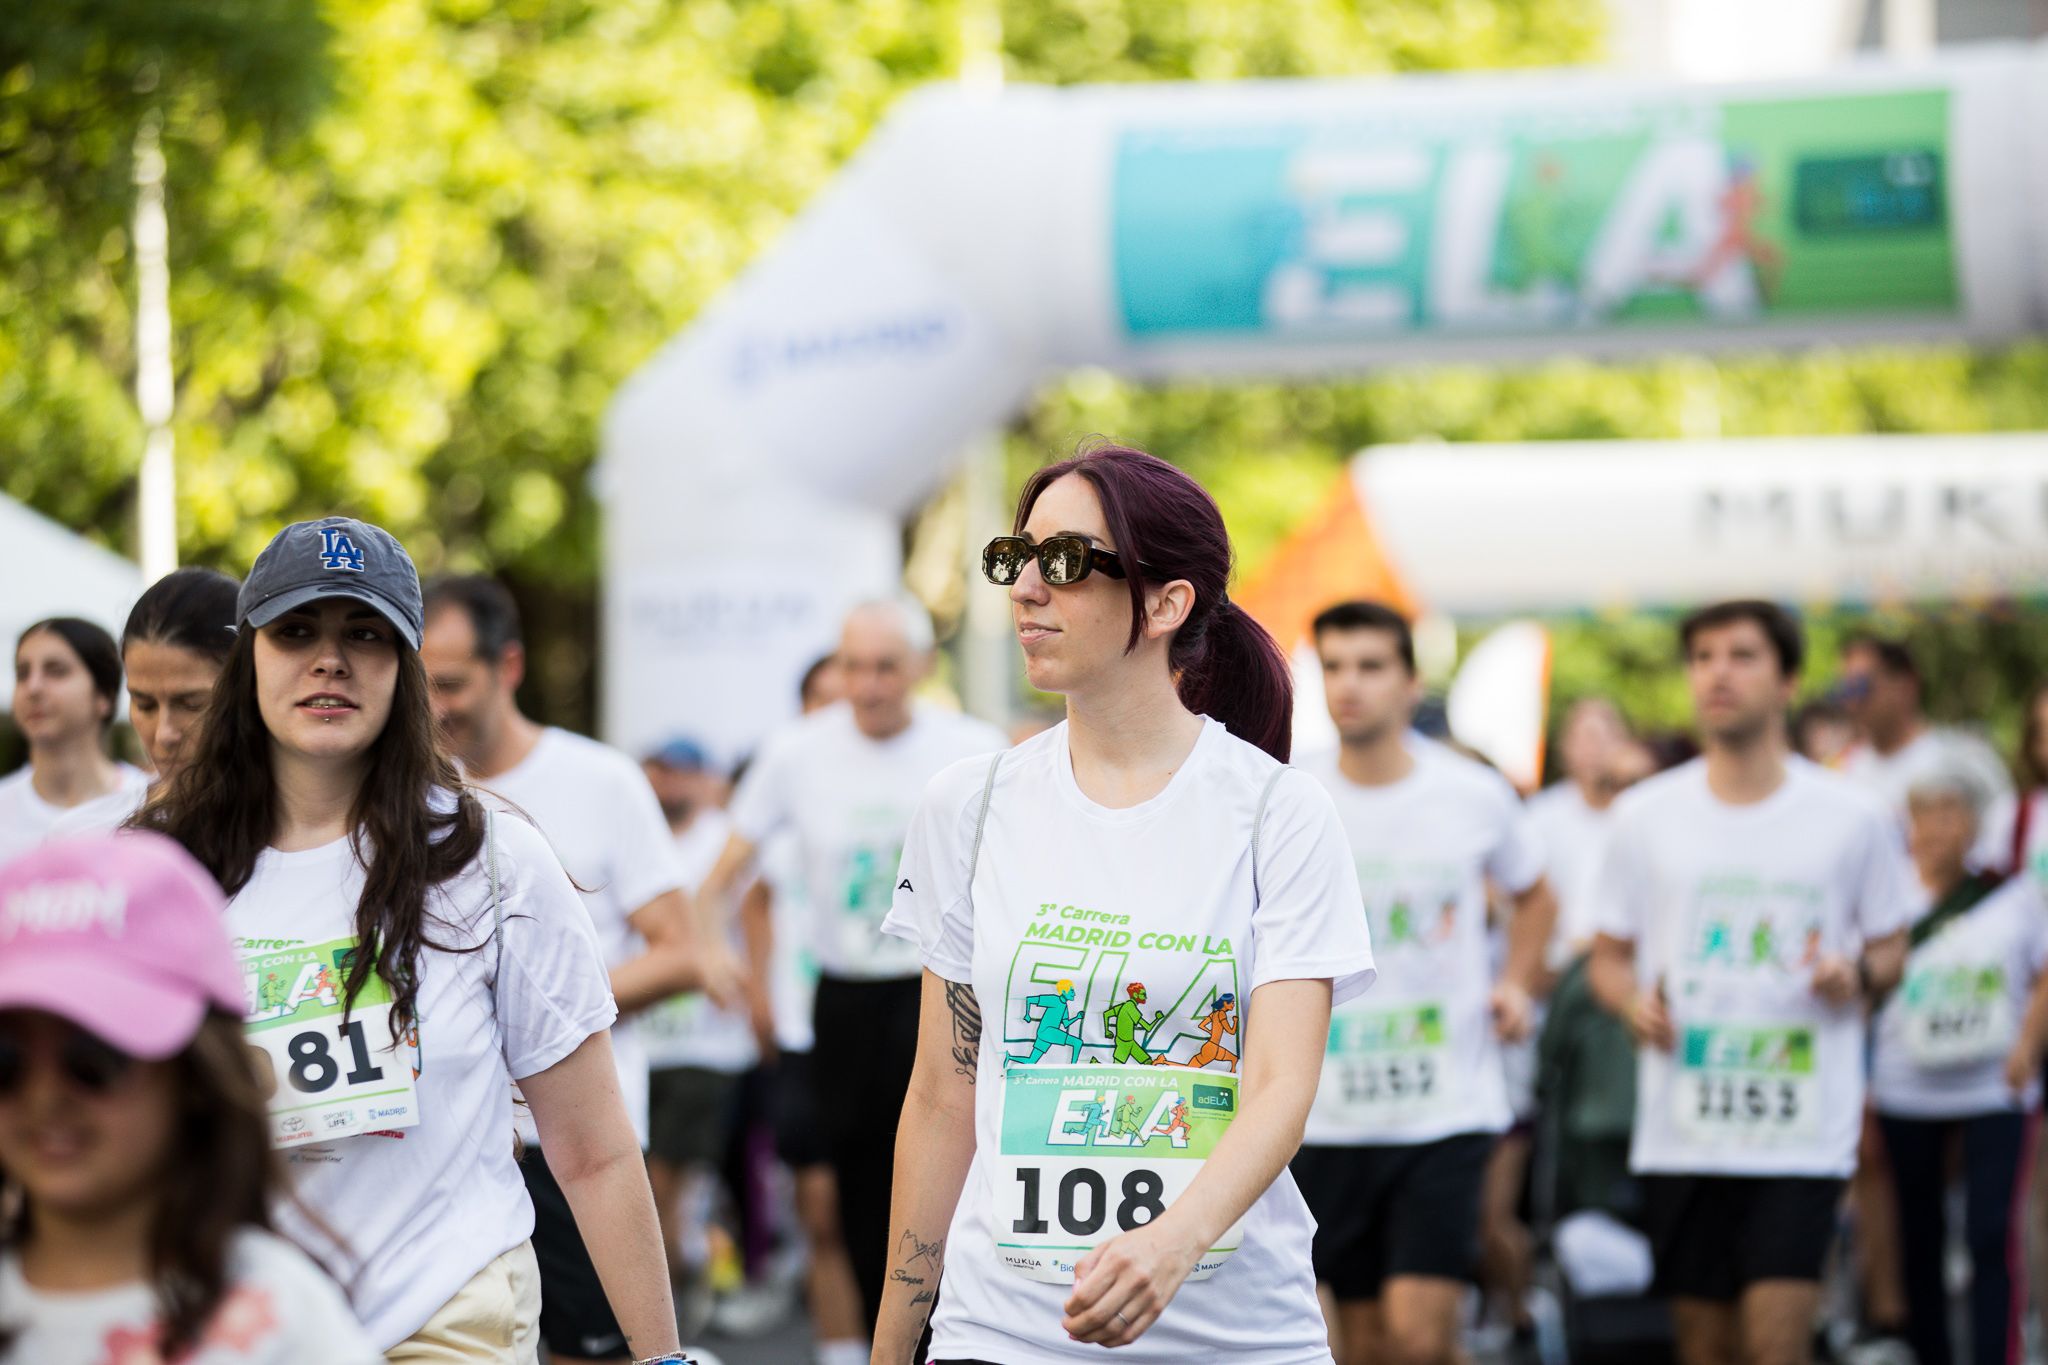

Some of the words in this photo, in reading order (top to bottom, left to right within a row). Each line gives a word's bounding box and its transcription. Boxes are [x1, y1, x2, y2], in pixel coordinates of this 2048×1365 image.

[1262, 136, 1764, 325] ELA
[1694, 482, 2048, 546] MUK
[319, 528, 364, 572] LA
[1060, 905, 1131, 925] Carrera
[1024, 922, 1132, 948] MADRID
[1137, 932, 1198, 952] CON
[1202, 935, 1234, 955] LA
[261, 954, 295, 968] CON
[298, 950, 318, 962] LA
[243, 962, 338, 1024] LA
[1003, 941, 1241, 1060] ELA
[1025, 1076, 1060, 1086] Carrera
[1062, 1075, 1121, 1088] MADRID
[1124, 1076, 1156, 1088] CON
[1159, 1077, 1179, 1088] LA
[378, 1106, 408, 1118] MADRID
[1198, 1095, 1229, 1107] adELA
[1046, 1089, 1189, 1149] ELA
[1012, 1168, 1167, 1237] 108
[1005, 1256, 1042, 1267] MUKUA
[1060, 1263, 1077, 1273] Bio
